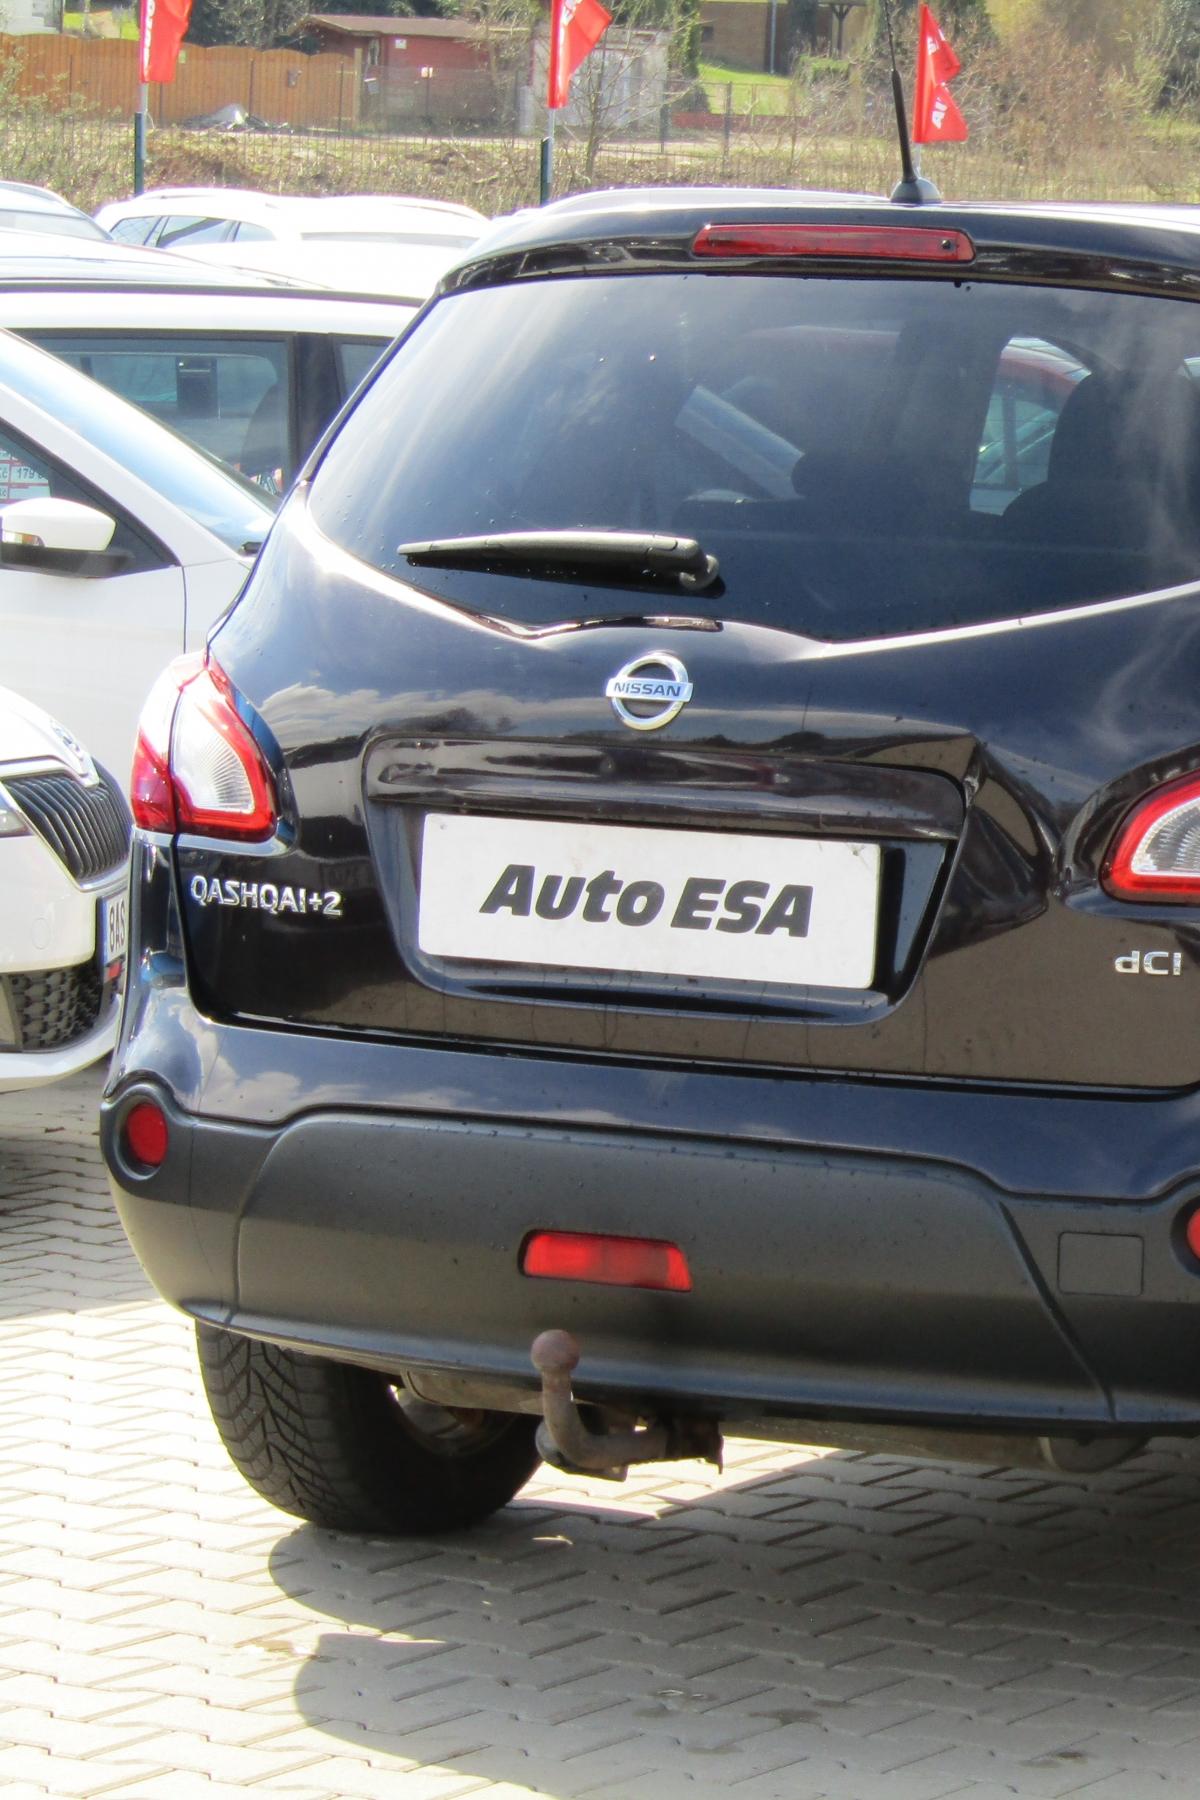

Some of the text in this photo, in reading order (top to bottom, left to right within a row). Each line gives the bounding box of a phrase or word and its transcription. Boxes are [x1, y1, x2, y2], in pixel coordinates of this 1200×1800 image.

[613, 682, 682, 697] NISSAN
[190, 874, 344, 917] QASHQAI+2
[478, 863, 814, 939] Auto ESA
